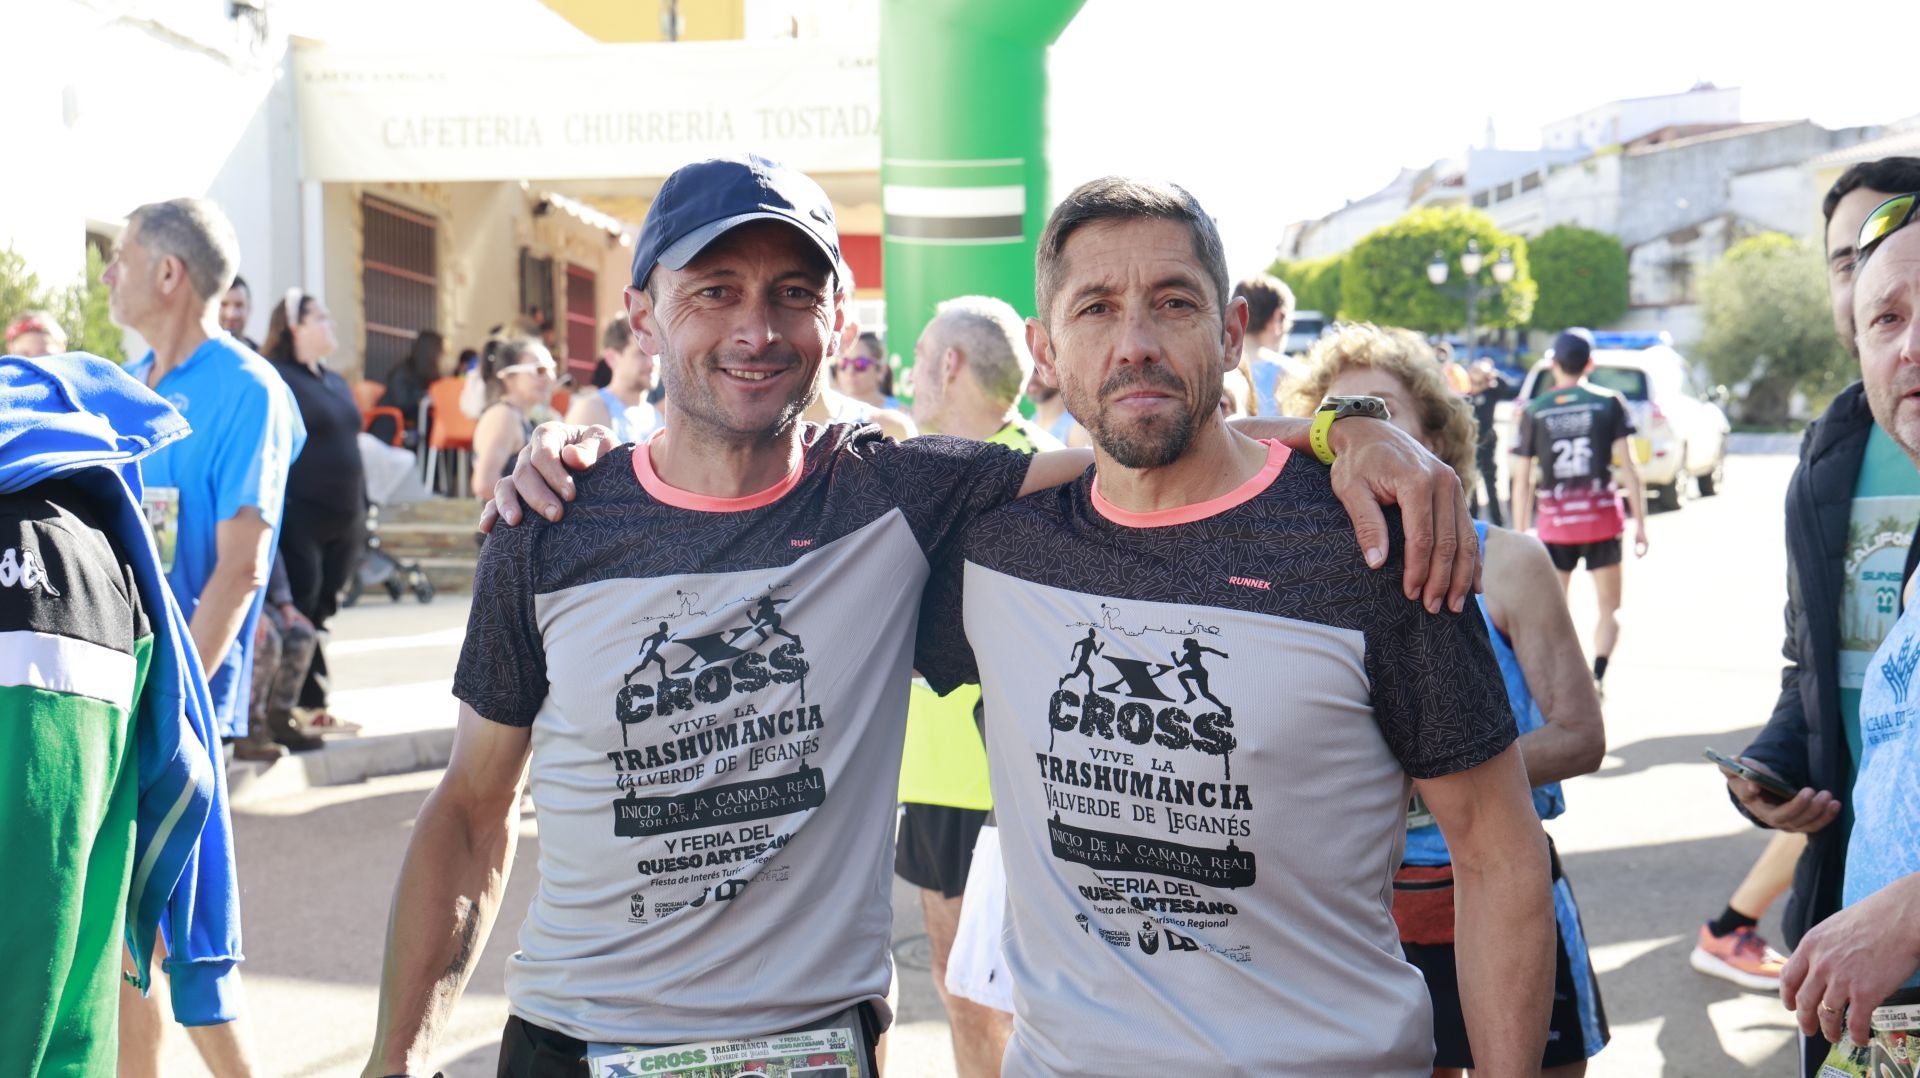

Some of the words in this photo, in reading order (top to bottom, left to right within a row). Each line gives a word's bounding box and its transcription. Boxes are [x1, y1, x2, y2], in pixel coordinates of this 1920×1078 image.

[564, 102, 736, 146] CHURRERÍA
[1229, 575, 1272, 590] RUNNEK
[615, 642, 810, 725] CROSS
[1098, 655, 1177, 703] X
[669, 714, 718, 736] VIVE
[734, 704, 759, 718] LA
[1048, 689, 1237, 756] CROSS
[607, 704, 825, 772] TRASHUMANCIA
[615, 763, 705, 792] VALVERDE
[714, 755, 738, 775] DE
[748, 735, 820, 772] LEGANÉS
[1088, 747, 1134, 766] VIVE
[1150, 757, 1176, 774] LA
[621, 804, 662, 819] INICIO
[668, 802, 686, 816] DE
[694, 798, 709, 811] LA
[715, 786, 780, 808] CAÑADA
[787, 775, 822, 793] REAL
[1036, 751, 1253, 811] TRASHUMANCIA
[639, 813, 700, 828] SORIANA
[711, 796, 806, 818] OCCIDENTAL
[1043, 782, 1121, 819] VALVERDE
[1132, 804, 1156, 824] DE
[1165, 807, 1251, 837] LEGANÉS
[637, 854, 703, 876] QUESO
[704, 832, 797, 867] ARTESAN
[664, 838, 678, 854] Y
[681, 829, 736, 852] FERIA
[738, 823, 775, 842] DEL
[1051, 827, 1083, 848] INICIO
[1090, 837, 1107, 853] DE
[1115, 841, 1132, 856] LA
[1137, 844, 1203, 868] CAÑADA
[1211, 856, 1251, 871] REAL
[650, 876, 677, 887] Fiesta
[679, 875, 690, 884] de
[690, 871, 720, 882] Interés
[1067, 846, 1122, 863] SORIANA
[1134, 856, 1232, 879] OCCIDENTAL
[1078, 884, 1126, 901] QUES
[1130, 896, 1239, 915] ARTESANO
[1163, 880, 1202, 898] DEL
[1115, 905, 1126, 914] de
[1187, 918, 1229, 930] Regional
[640, 1048, 708, 1072] CROSS
[711, 1040, 769, 1054] TRASHUMANCIA
